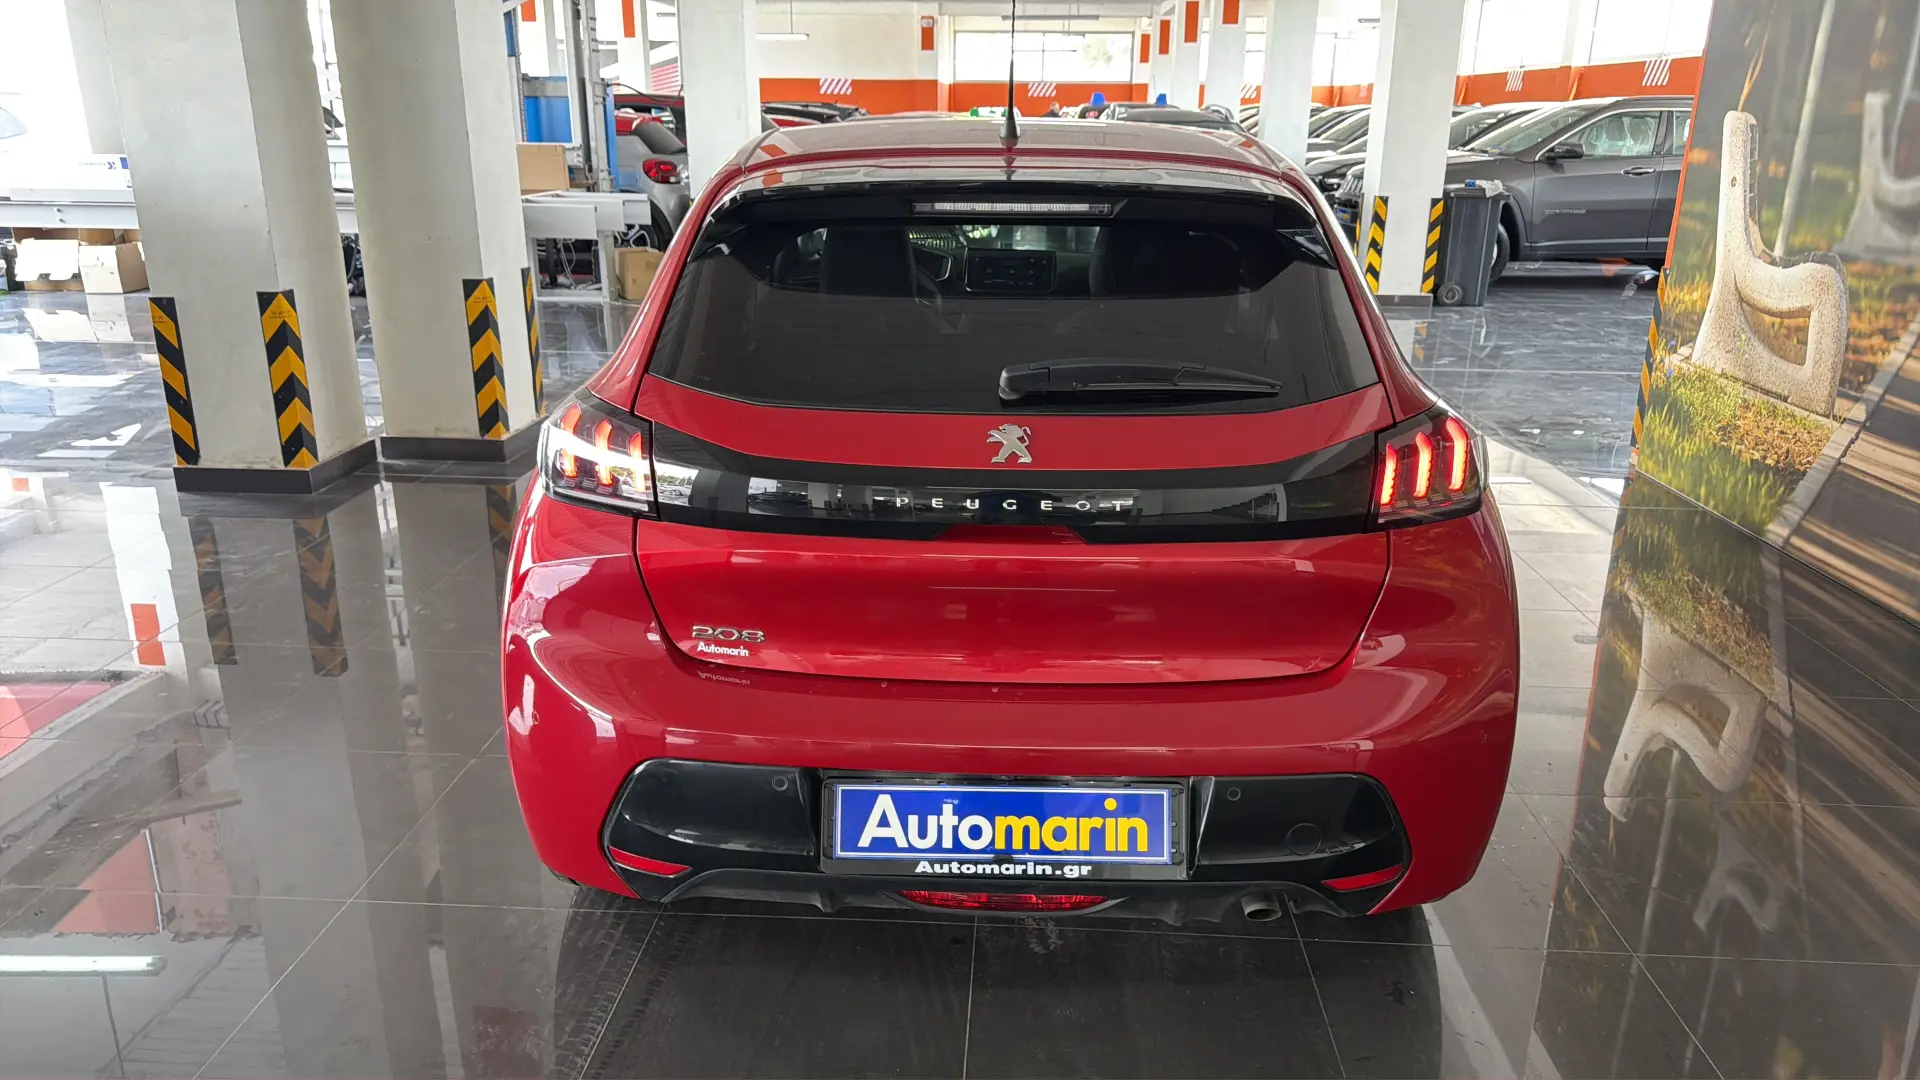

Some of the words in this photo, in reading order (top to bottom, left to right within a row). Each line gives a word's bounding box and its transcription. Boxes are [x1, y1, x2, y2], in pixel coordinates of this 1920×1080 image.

[896, 497, 1125, 511] PEUGEOT
[692, 626, 765, 643] 208
[697, 641, 749, 657] Automarin
[857, 794, 1148, 852] Automarin
[915, 860, 1092, 878] Automarin.gr
